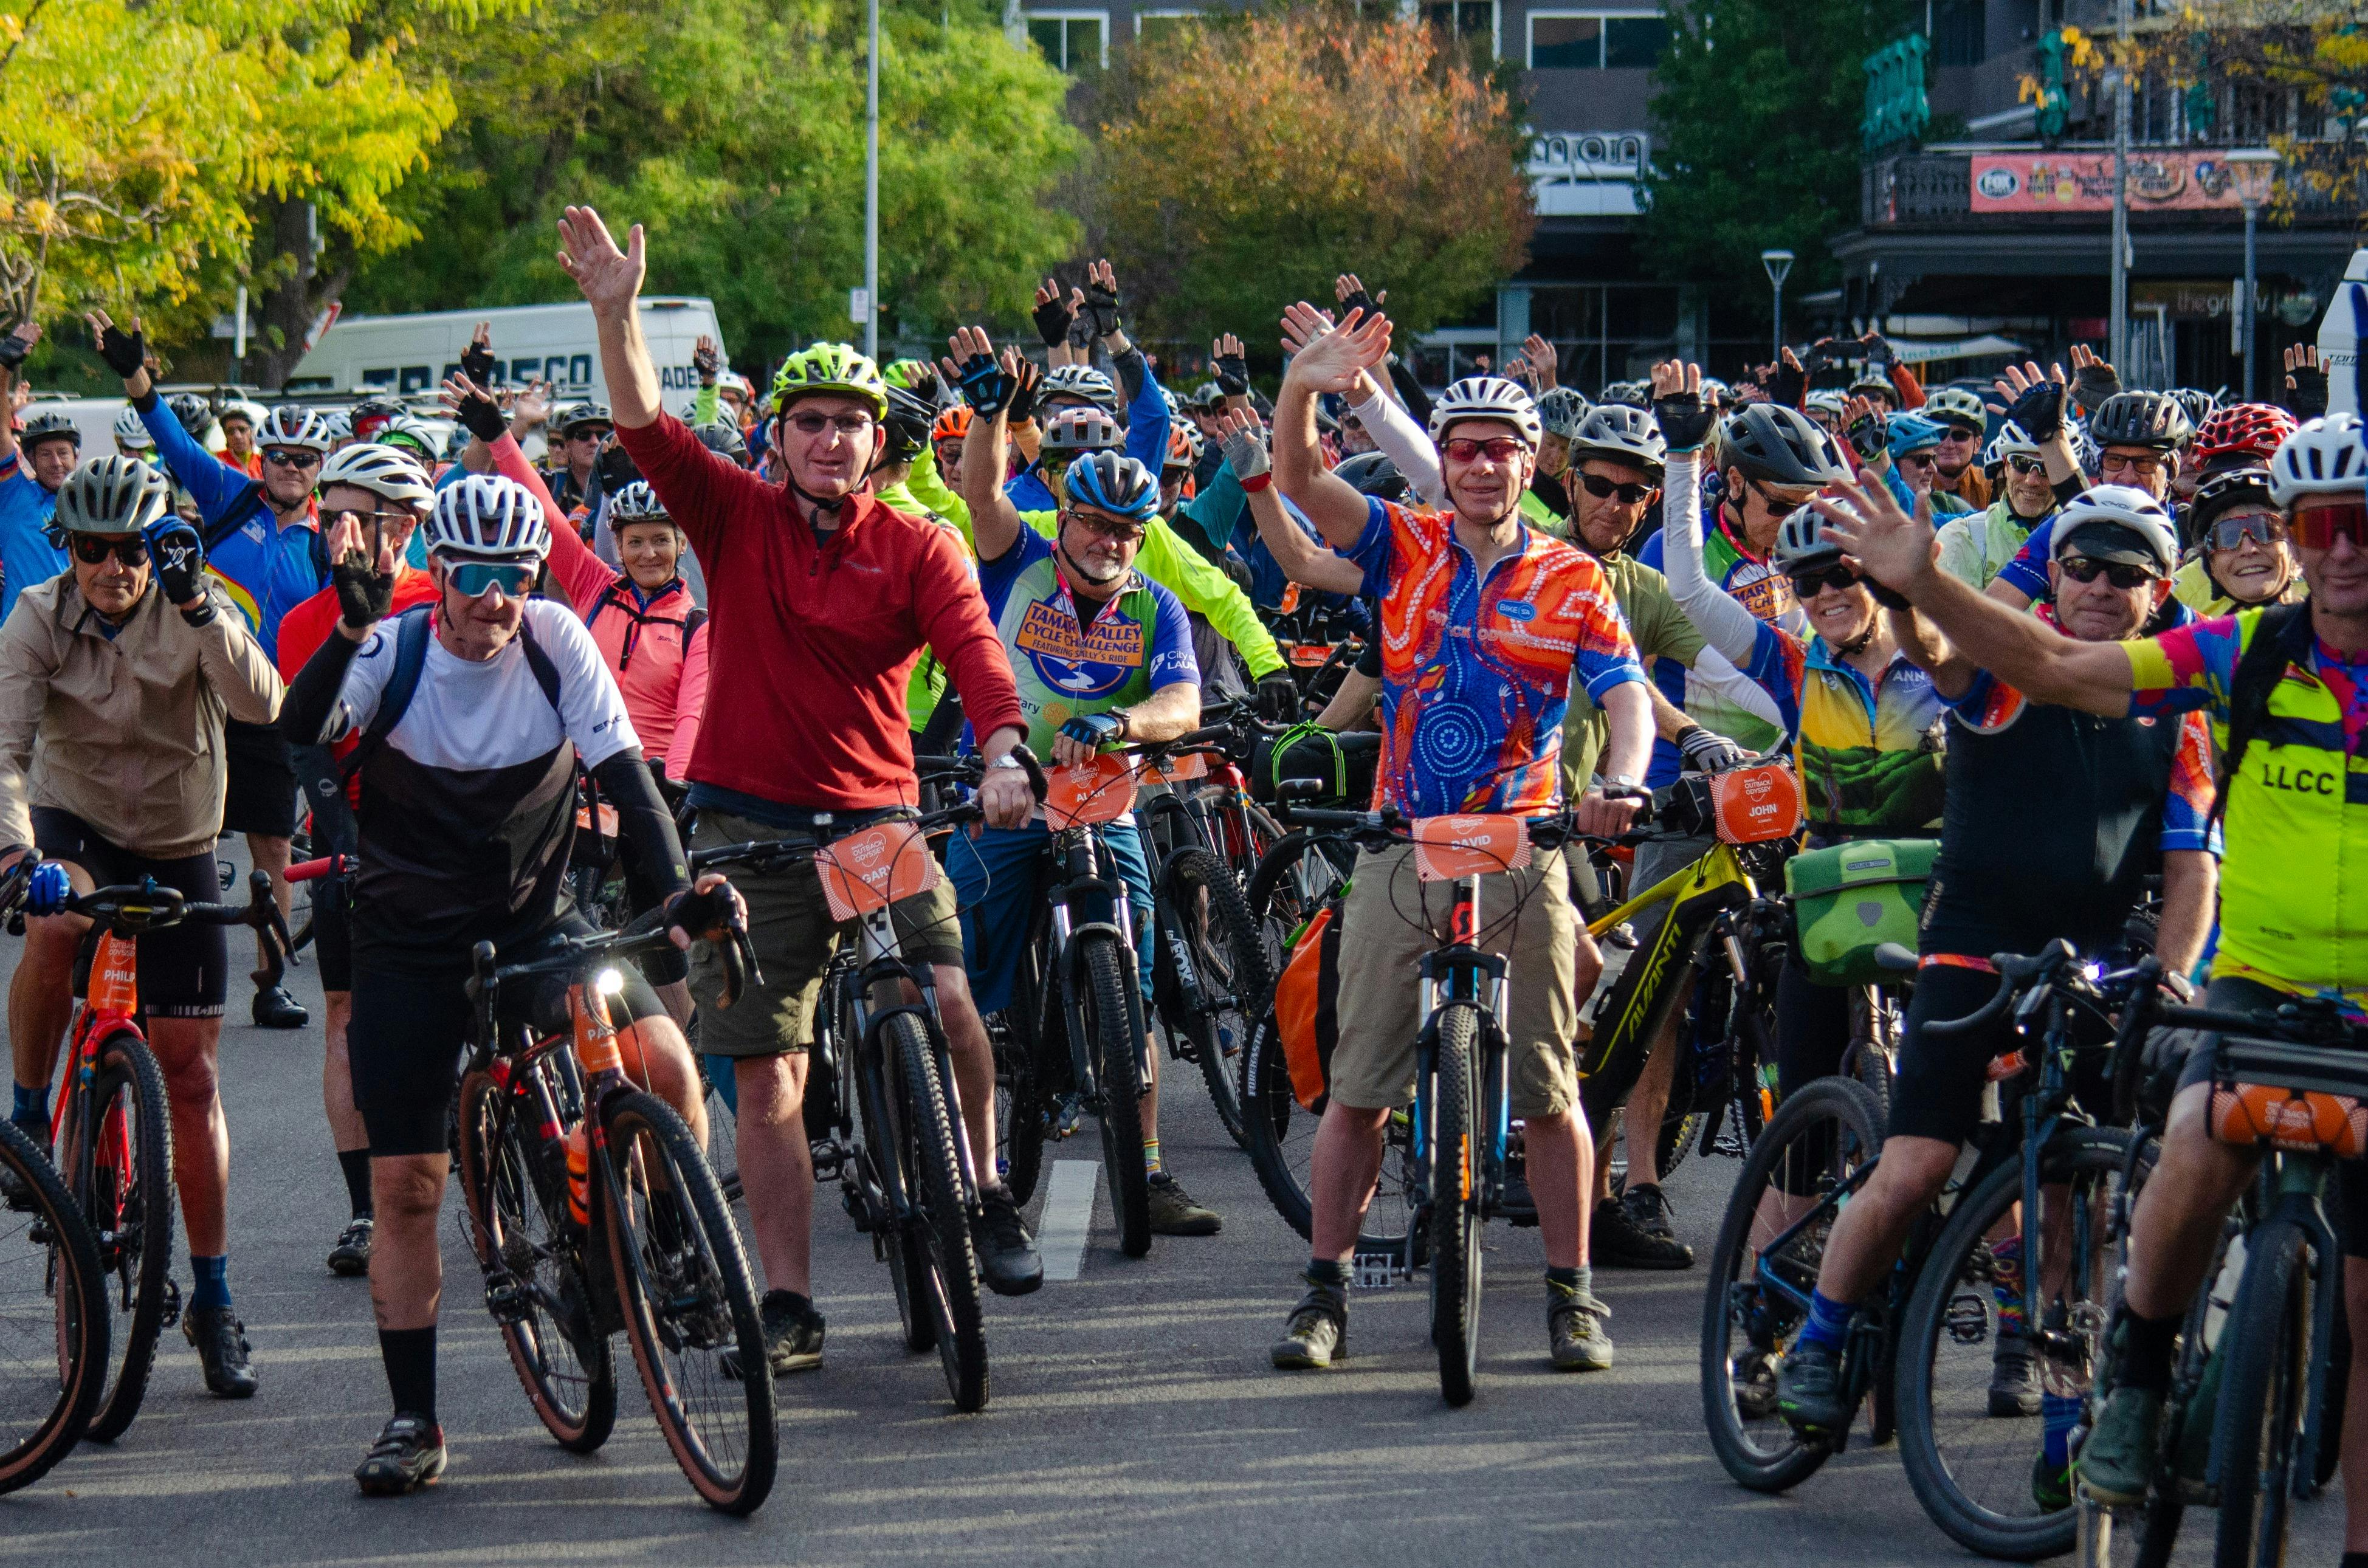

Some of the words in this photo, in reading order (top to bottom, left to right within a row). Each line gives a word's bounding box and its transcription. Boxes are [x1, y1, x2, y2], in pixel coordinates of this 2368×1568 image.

[1499, 603, 1518, 614] BIKE
[1032, 605, 1077, 634] TAMAR
[1089, 625, 1142, 641] VALLEY
[1024, 621, 1062, 643] CYCLE
[1064, 634, 1140, 653] CHALLENGE
[1032, 638, 1073, 658] FEATURING
[1108, 653, 1128, 663] RIDE
[1167, 650, 1188, 661] City
[1744, 780, 1771, 789] OUTBACK
[2262, 763, 2335, 795] LLCC
[1076, 788, 1106, 802] ALAN
[1745, 786, 1771, 796] ODYSSEY
[1749, 803, 1777, 817] JOHN
[853, 840, 884, 856] OUTBACK
[1451, 834, 1492, 851] DAVID
[854, 845, 885, 863] ODYSSEY
[1169, 941, 1196, 984] FOX
